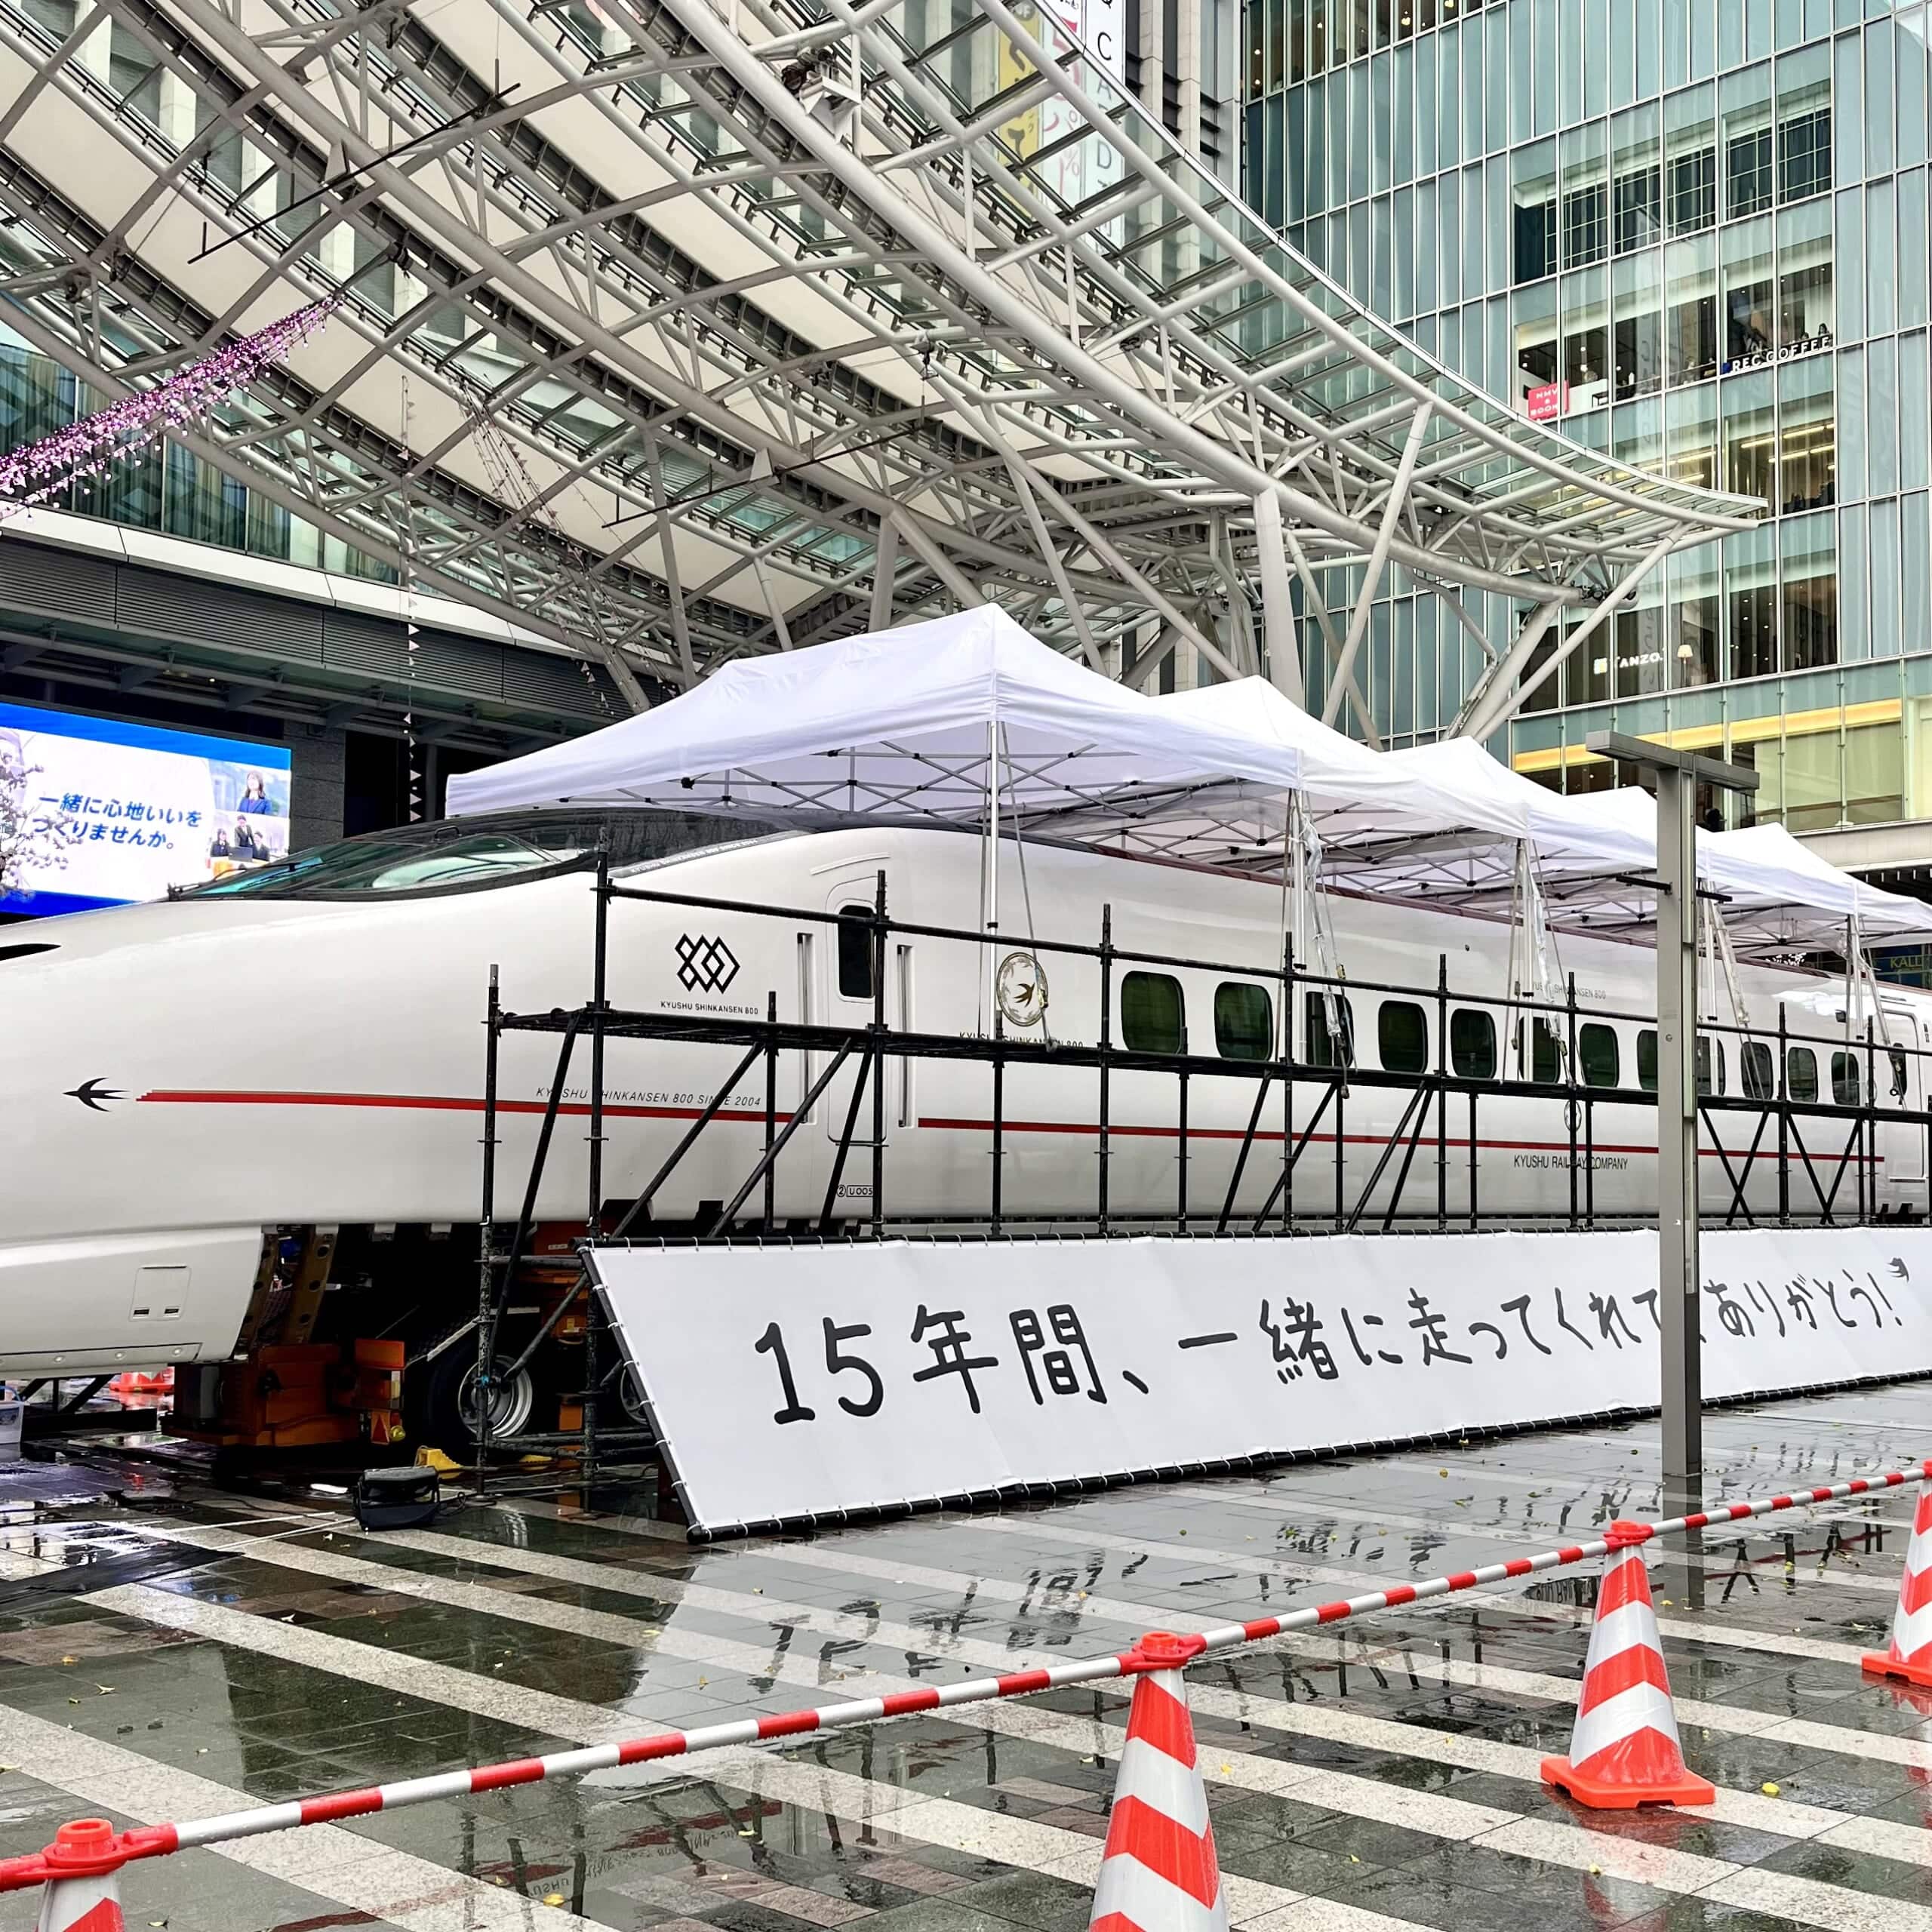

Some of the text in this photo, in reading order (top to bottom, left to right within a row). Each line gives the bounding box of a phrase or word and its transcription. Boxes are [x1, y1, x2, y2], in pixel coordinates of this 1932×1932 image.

[1732, 354, 1761, 372] REC
[1766, 336, 1829, 362] COFFEE
[39, 792, 202, 828] 一緒に心地いいを
[32, 817, 174, 850] つくりませんか。
[660, 1001, 758, 1015] KYUSHU SHINKANSEN 800
[536, 1087, 761, 1106] KYSHU HINKANSEN 800 SINE 2004
[1514, 1155, 1549, 1168] KYUSHU
[1552, 1155, 1586, 1169] RAILAY
